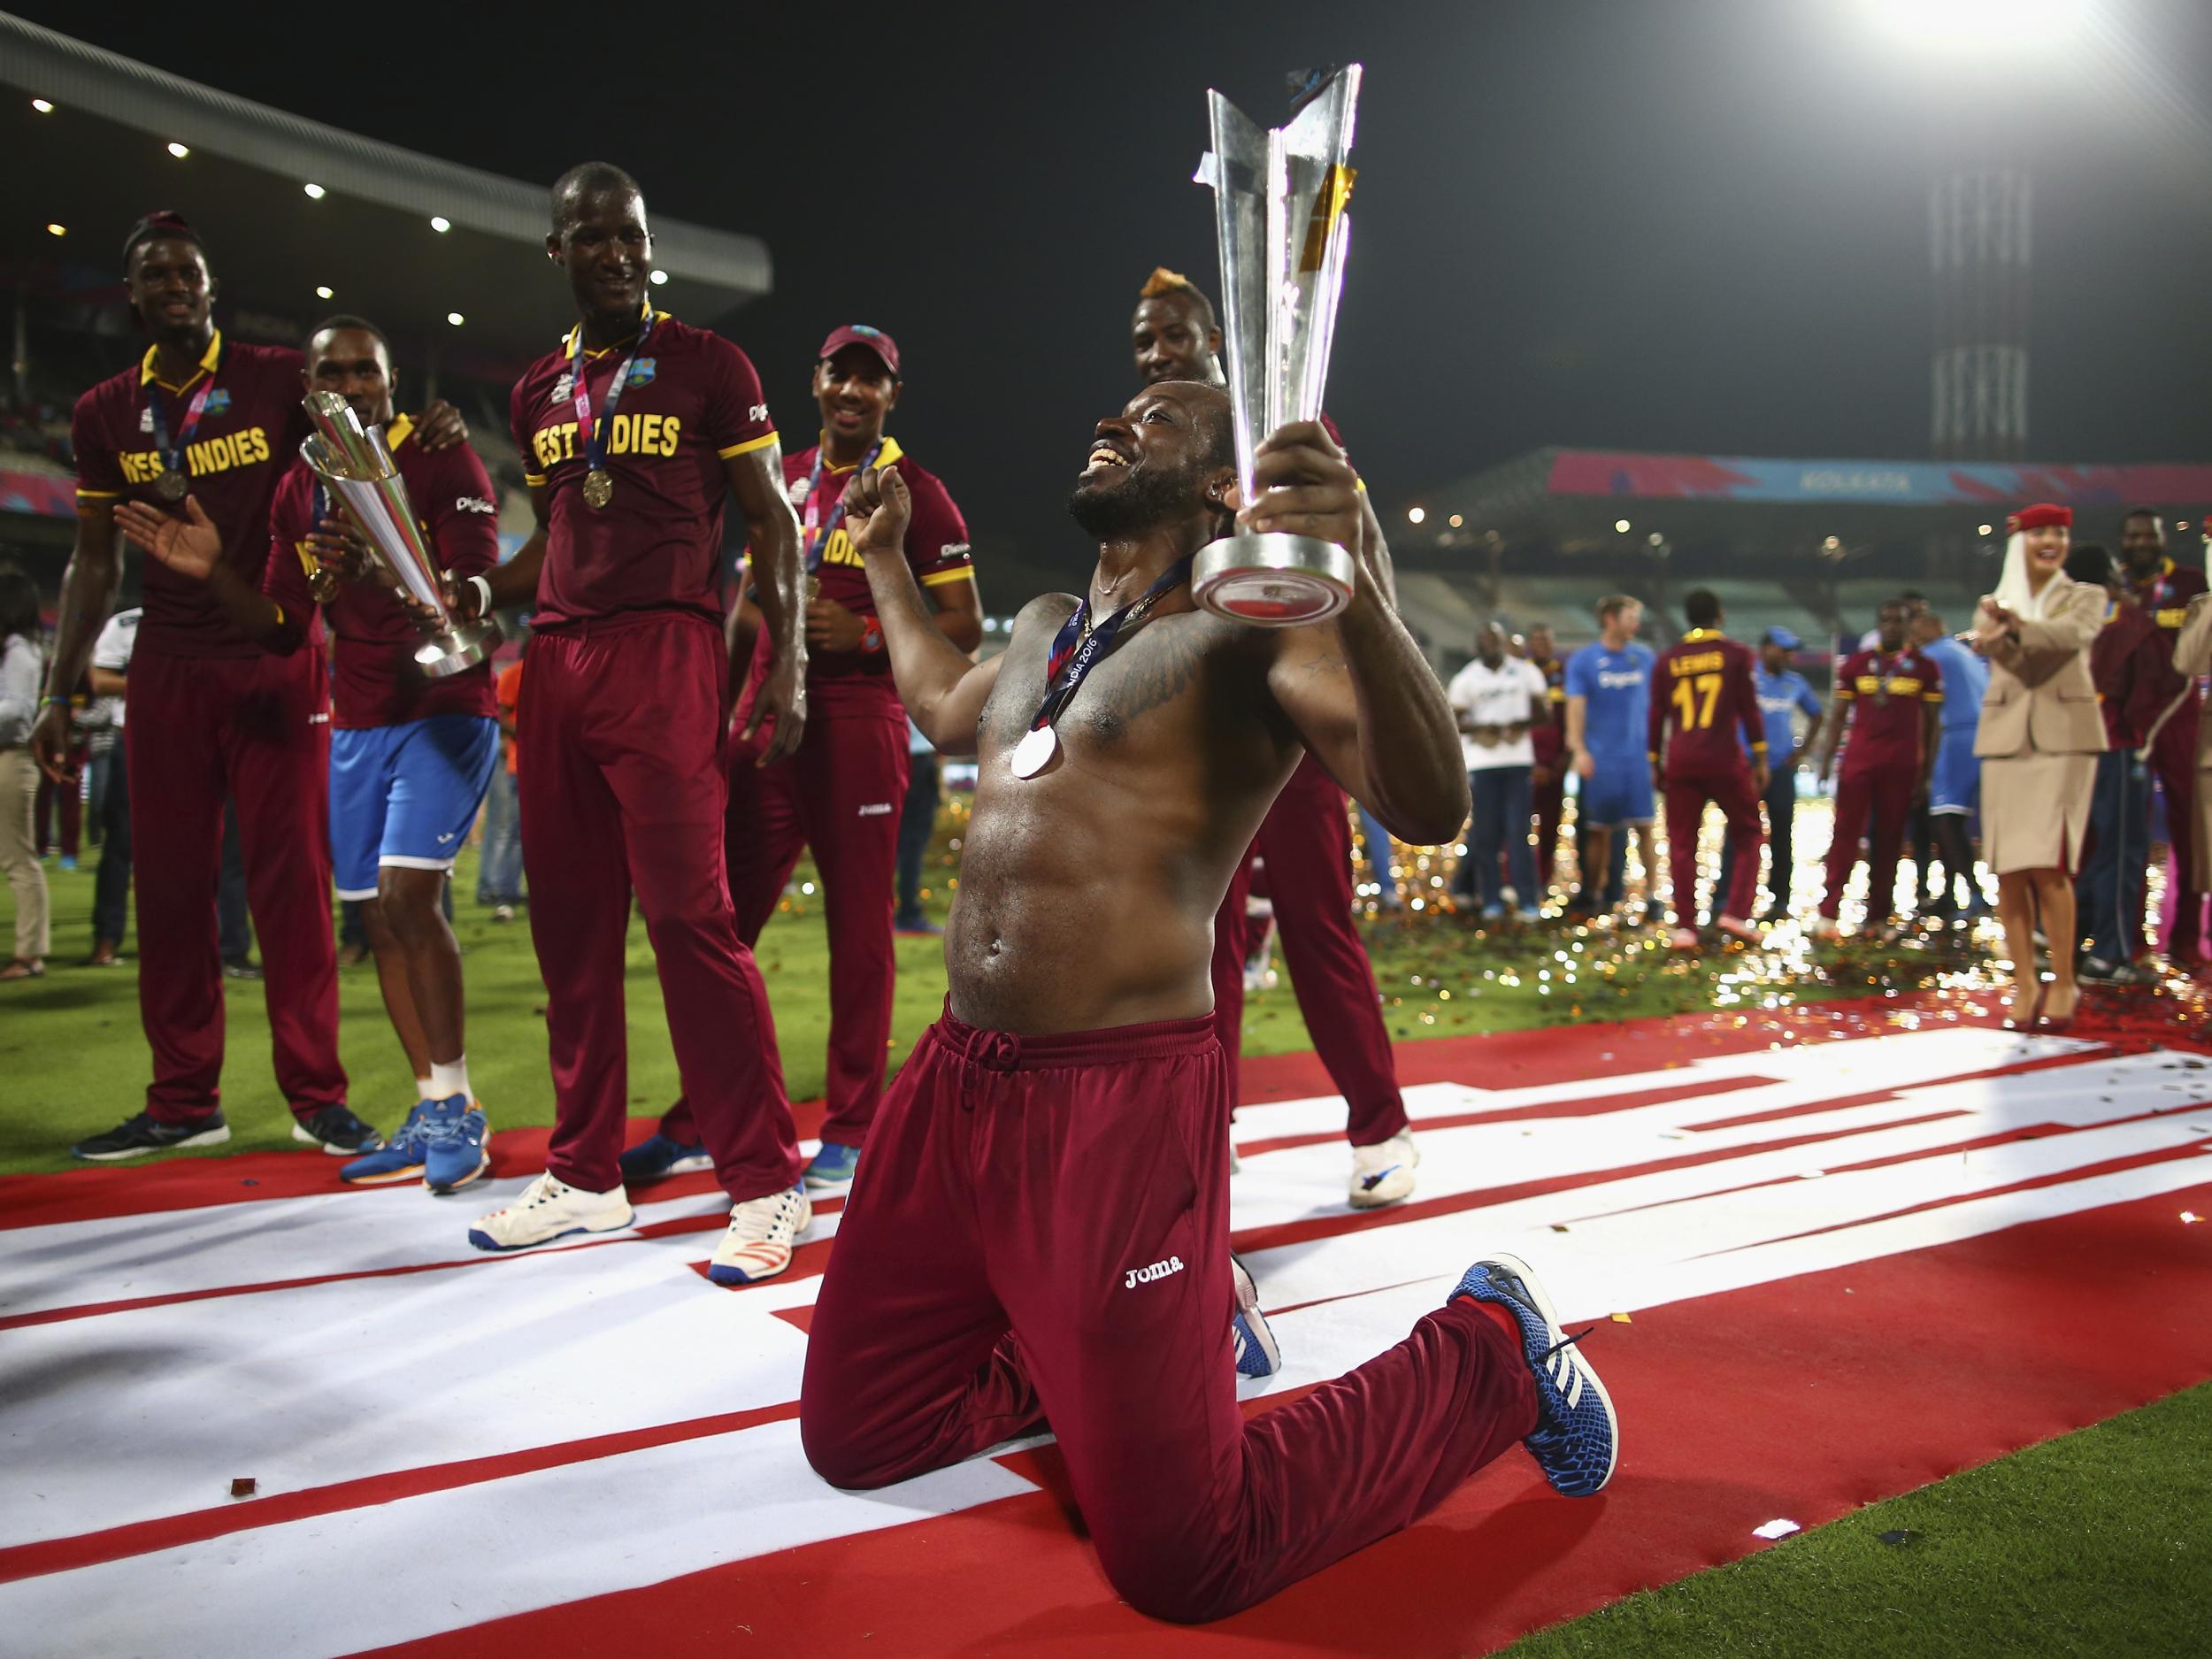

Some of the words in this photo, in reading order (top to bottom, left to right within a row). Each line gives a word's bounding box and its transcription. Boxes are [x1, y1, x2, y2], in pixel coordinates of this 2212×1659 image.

[186, 426, 270, 477] INDIES
[533, 422, 578, 468] EST
[1066, 662, 1086, 688] NDIA
[1079, 637, 1097, 664] 2016
[1670, 650, 1724, 678] LEWIS
[1671, 673, 1723, 732] 17
[1125, 1256, 1184, 1289] Joma
